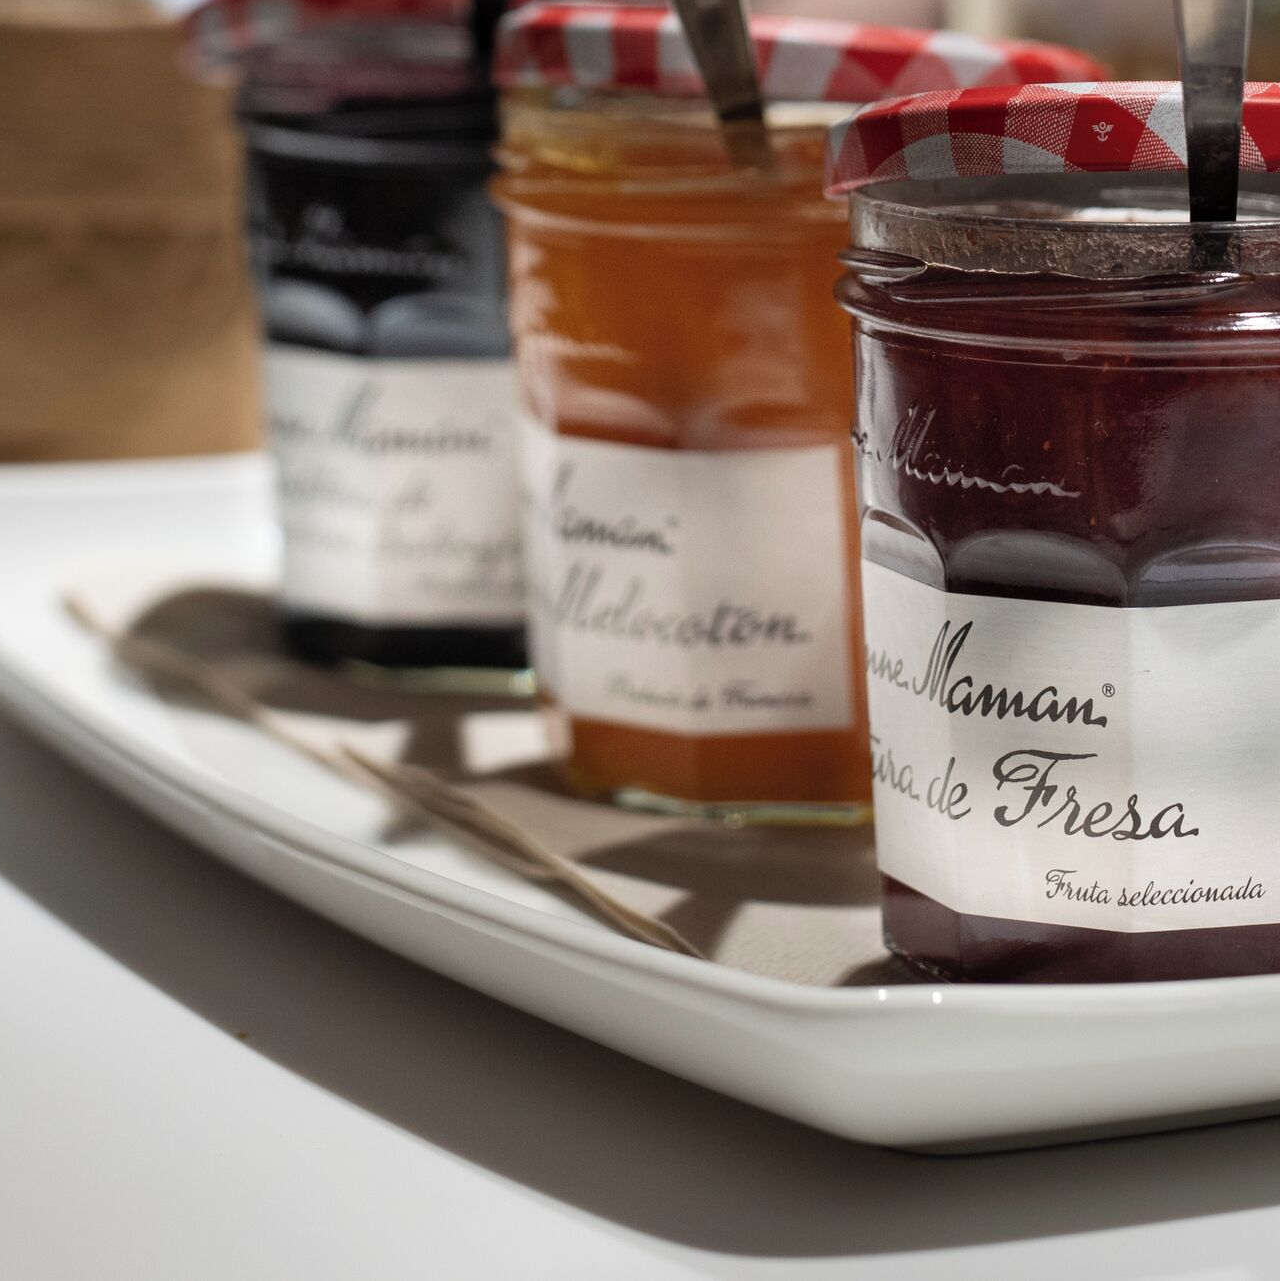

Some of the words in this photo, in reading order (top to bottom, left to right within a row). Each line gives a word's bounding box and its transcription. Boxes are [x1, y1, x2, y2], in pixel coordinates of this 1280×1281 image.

[926, 756, 972, 820] de
[993, 749, 1199, 841] Fresa
[1045, 868, 1112, 905] Fruta
[1117, 876, 1267, 907] seleccionada
